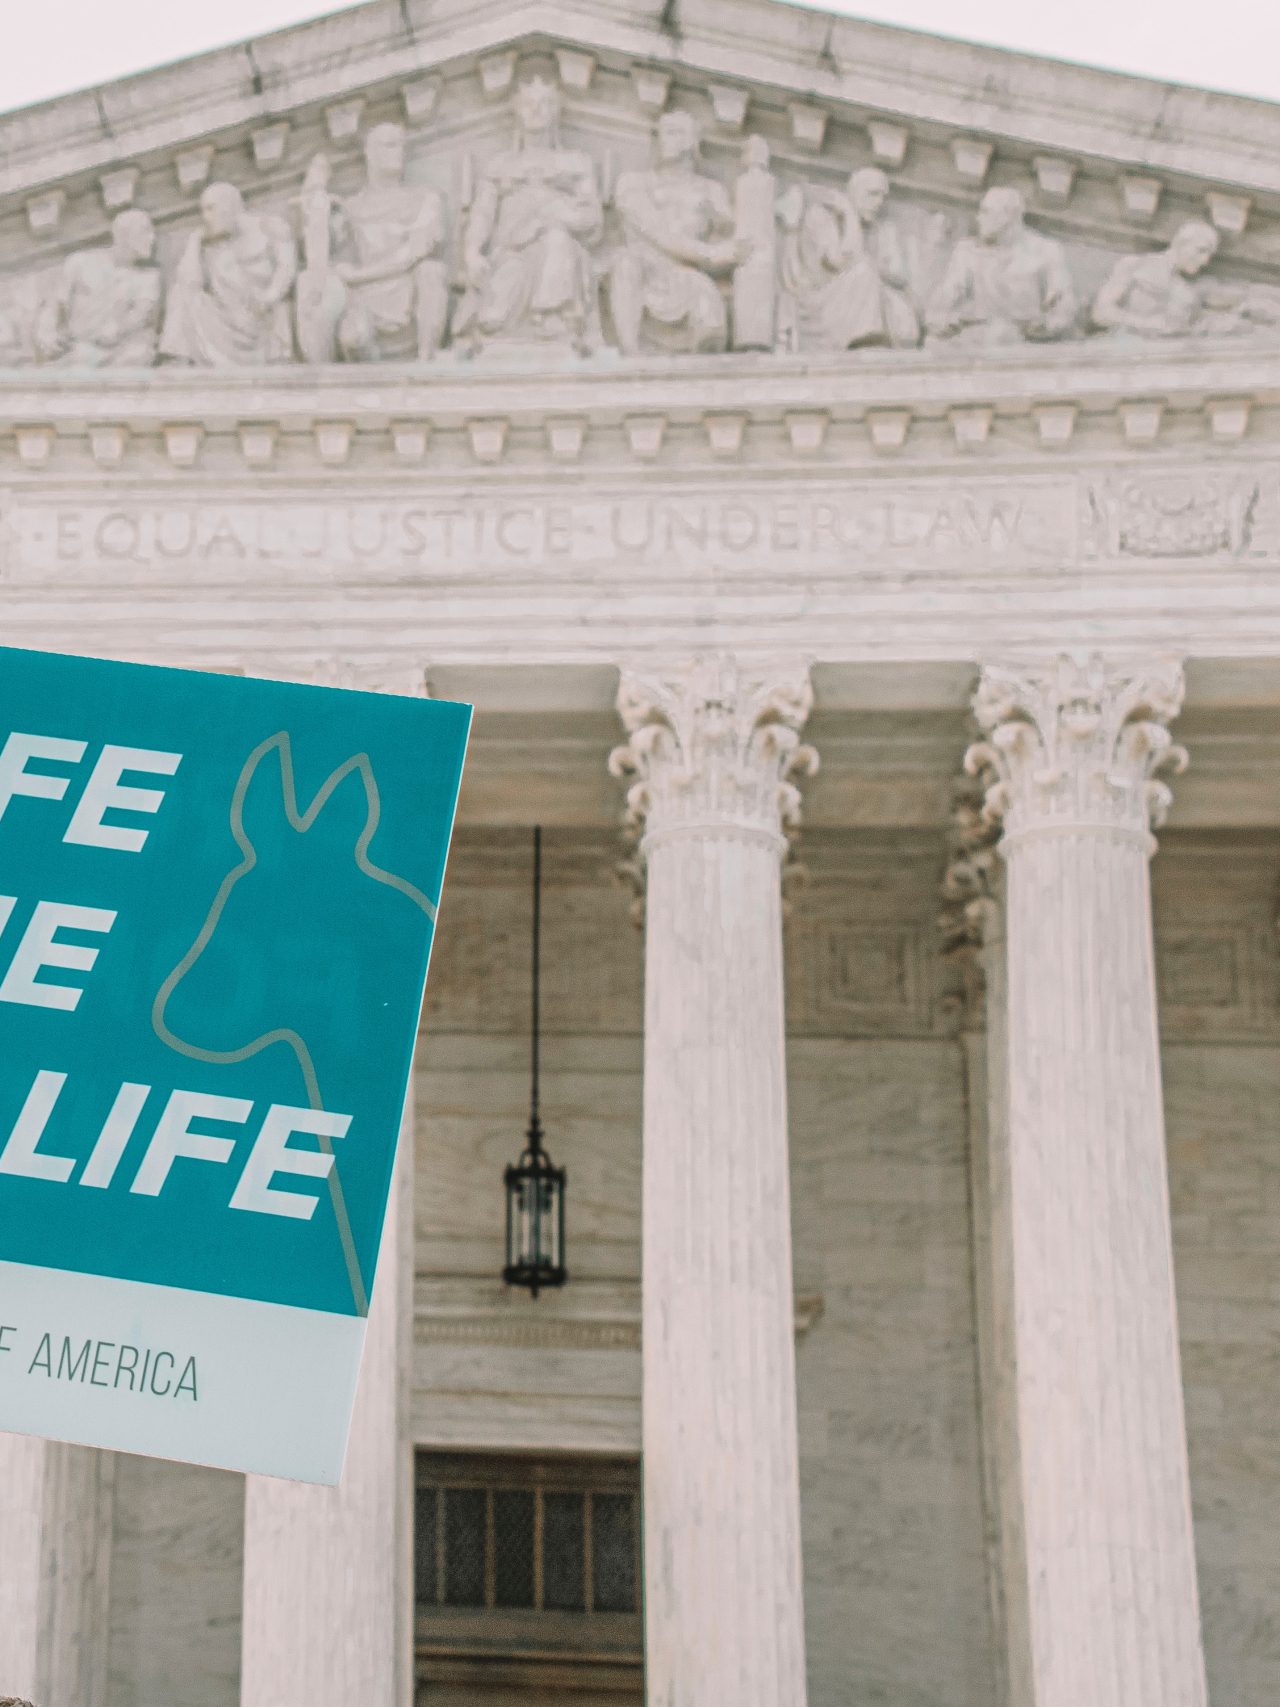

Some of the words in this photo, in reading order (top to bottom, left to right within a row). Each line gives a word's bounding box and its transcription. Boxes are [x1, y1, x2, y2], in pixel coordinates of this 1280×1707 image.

[55, 510, 281, 563] EQUAL
[301, 507, 573, 558] JUSTICE
[609, 501, 862, 553] UNDER
[880, 497, 1024, 549] LAW
[27, 1332, 199, 1402] AMERICA
